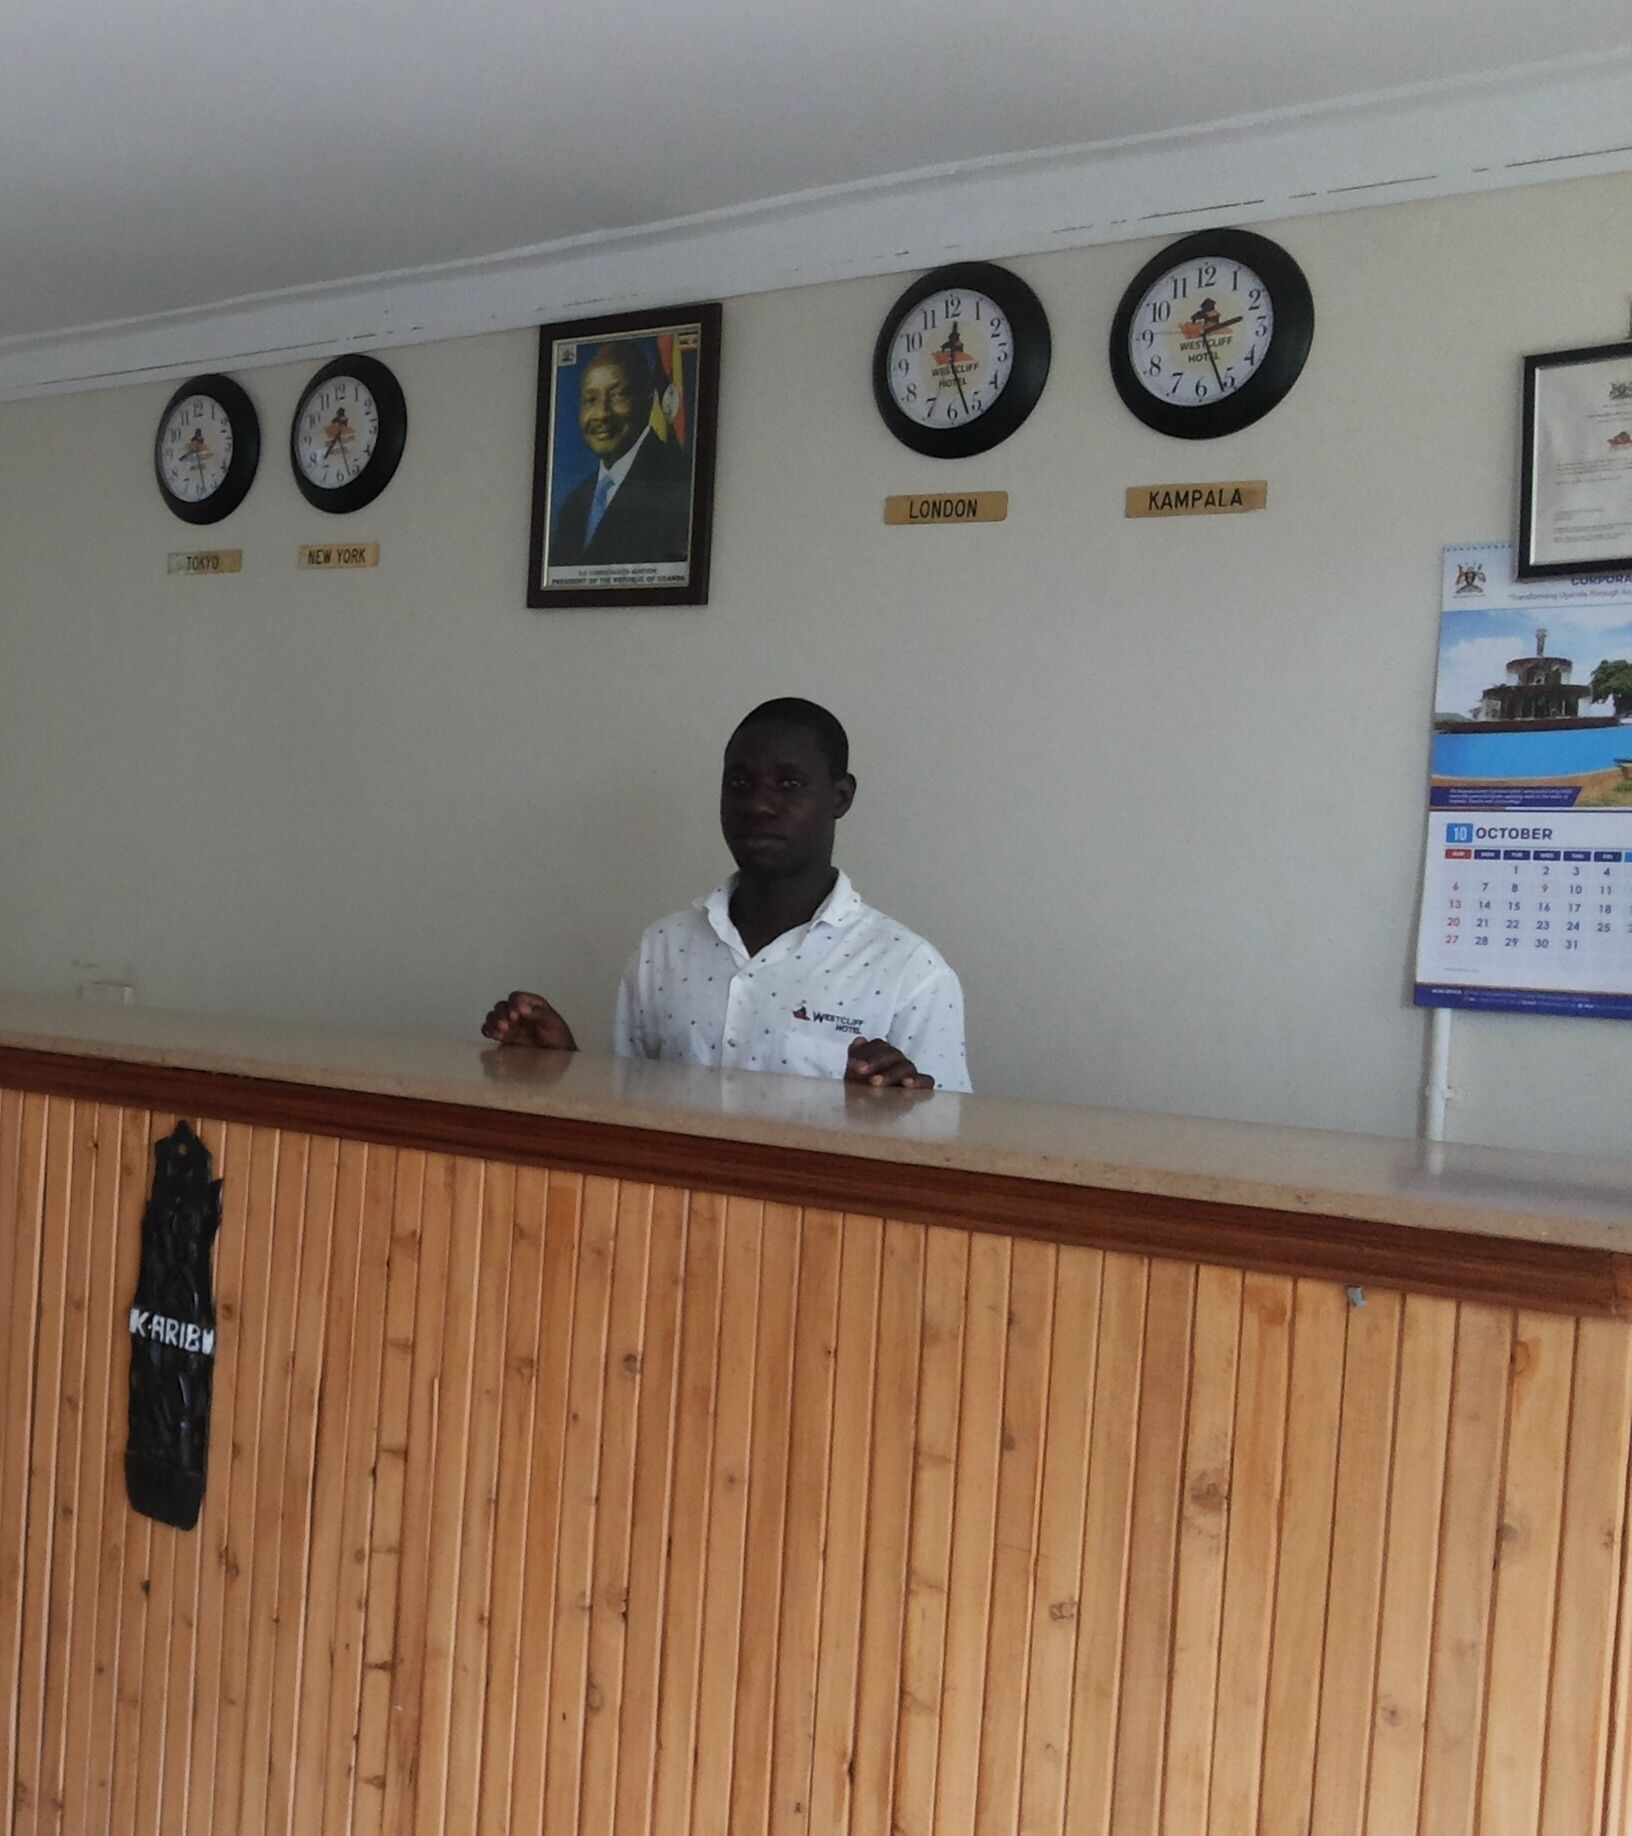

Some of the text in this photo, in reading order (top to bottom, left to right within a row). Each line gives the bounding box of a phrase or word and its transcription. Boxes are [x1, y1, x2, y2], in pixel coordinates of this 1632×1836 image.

[1197, 266, 1217, 288] 12
[1232, 271, 1238, 291] 1
[1173, 278, 1187, 299] 11
[945, 298, 961, 319] 12
[1248, 289, 1261, 311] 2
[923, 310, 937, 330] 11
[976, 301, 981, 320] 1
[1152, 300, 1171, 323] 10
[990, 318, 1001, 338] 2
[1255, 315, 1267, 338] 3
[906, 332, 923, 353] 10
[1142, 329, 1154, 349] 9
[997, 342, 1007, 363] 3
[1243, 344, 1255, 366] 4
[898, 358, 909, 377] 9
[931, 362, 979, 376] WESCLIFF
[1149, 355, 1162, 377] 8
[988, 369, 998, 389] 4
[1171, 372, 1183, 393] 7
[1195, 376, 1207, 397] 6
[1224, 367, 1235, 389] 5
[335, 383, 345, 401] 12
[906, 383, 917, 402] 8
[971, 390, 982, 411] 5
[320, 394, 330, 411] 11
[364, 400, 372, 416] 2
[926, 397, 937, 418] 7
[947, 402, 958, 420] 6
[309, 412, 321, 429] 10
[308, 453, 317, 469] 8
[322, 464, 330, 481] 7
[336, 469, 344, 481] 6
[909, 499, 977, 519] LONDON
[1148, 488, 1243, 511] KAMPALA
[186, 555, 219, 571] TOKYO
[308, 548, 366, 565] NEW YORK
[1453, 827, 1553, 841] 10 OCTOBER
[1514, 866, 1610, 876] 1 2 3 4
[1452, 882, 1612, 895] 6 7 8 9 10 11
[1449, 900, 1612, 914] 13 14 15 16 17 18
[1447, 917, 1611, 933] 20 21 22 23 24 25
[1445, 935, 1578, 949] 27 28 29 30 31
[813, 1010, 864, 1026] WESTCLIFF
[835, 1024, 862, 1035] HOTEL
